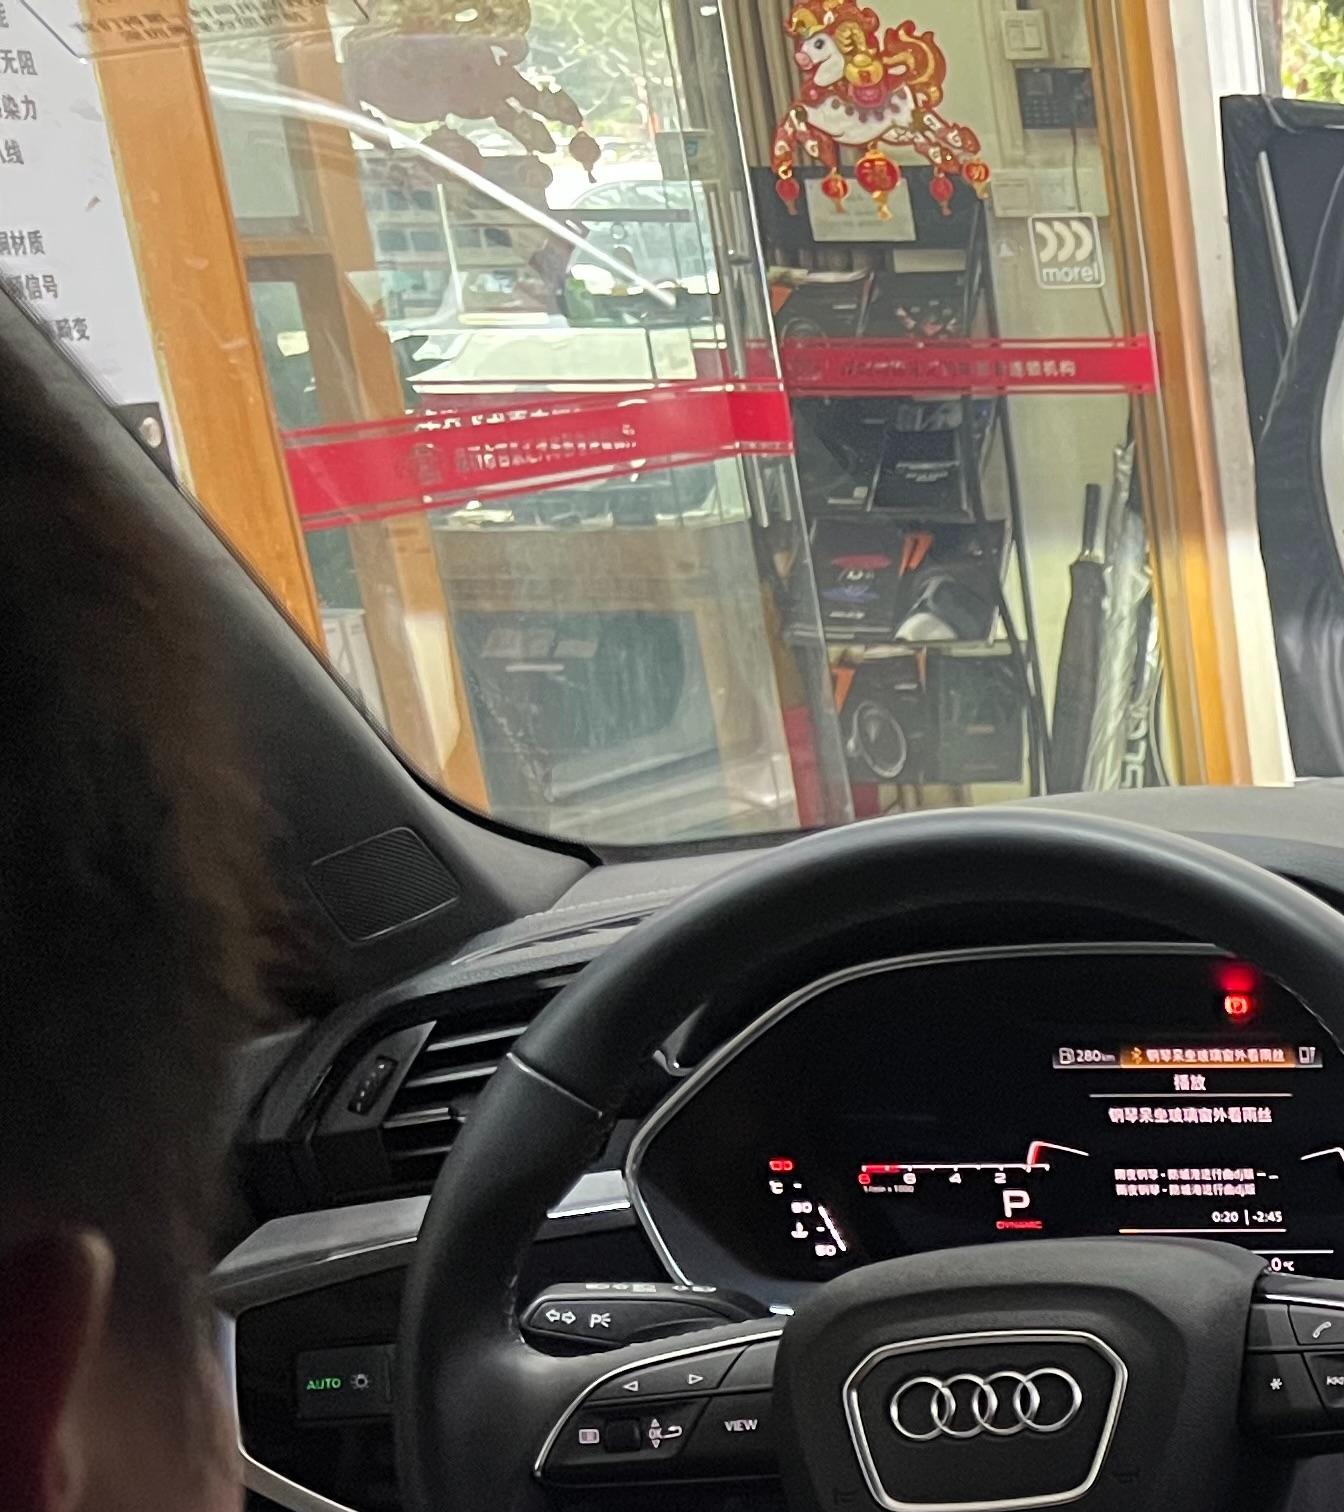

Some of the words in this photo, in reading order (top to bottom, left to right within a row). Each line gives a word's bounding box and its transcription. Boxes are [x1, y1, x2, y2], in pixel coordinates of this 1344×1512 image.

[0, 50, 37, 75] 无阻
[1043, 261, 1099, 282] morel
[1173, 1074, 1206, 1090] 播放
[949, 1173, 962, 1184] 4
[994, 1173, 1007, 1184] 2
[1002, 1190, 1031, 1218] P
[1211, 1211, 1239, 1222] 0:20
[306, 1376, 342, 1391] AUTO
[725, 1419, 758, 1431] VIEW
